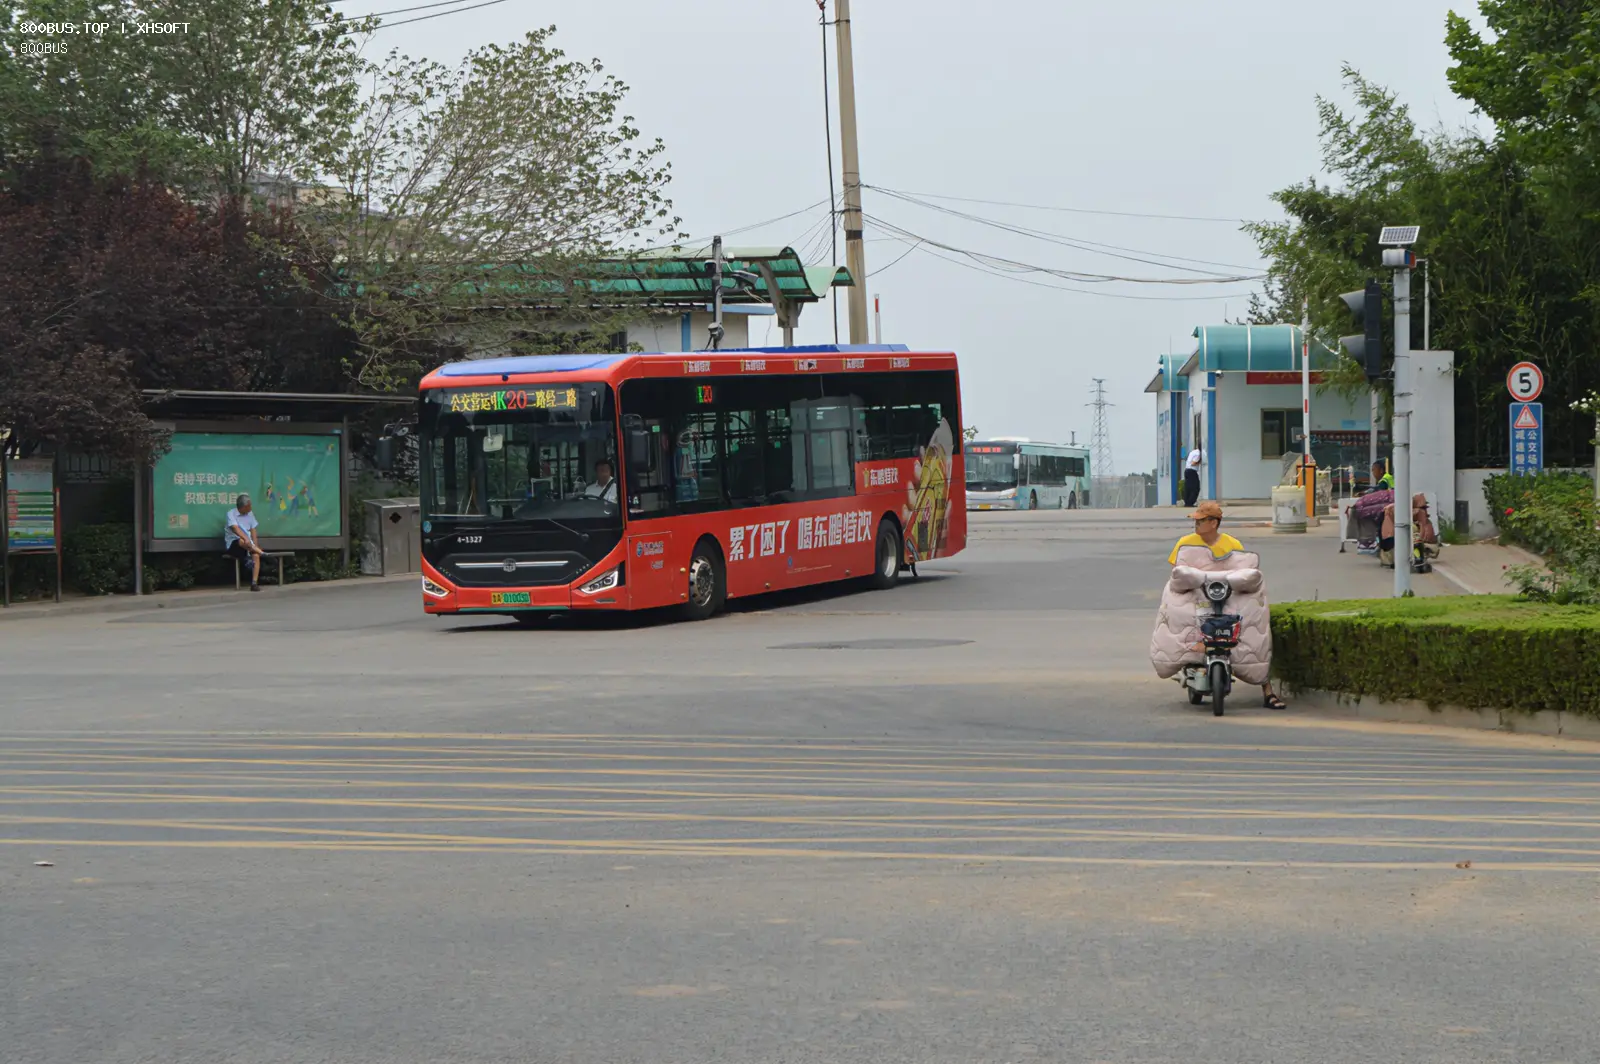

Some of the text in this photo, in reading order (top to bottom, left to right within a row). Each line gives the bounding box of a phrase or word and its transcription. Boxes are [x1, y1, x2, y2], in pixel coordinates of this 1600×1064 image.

[1519, 372, 1532, 393] 5
[496, 389, 528, 411] K20
[174, 472, 239, 485] 保持平和心态
[870, 467, 899, 485] 东鹏特饮
[185, 491, 249, 505] 积极乐观自
[729, 510, 873, 562] 累了困了 喝东鹏特饮
